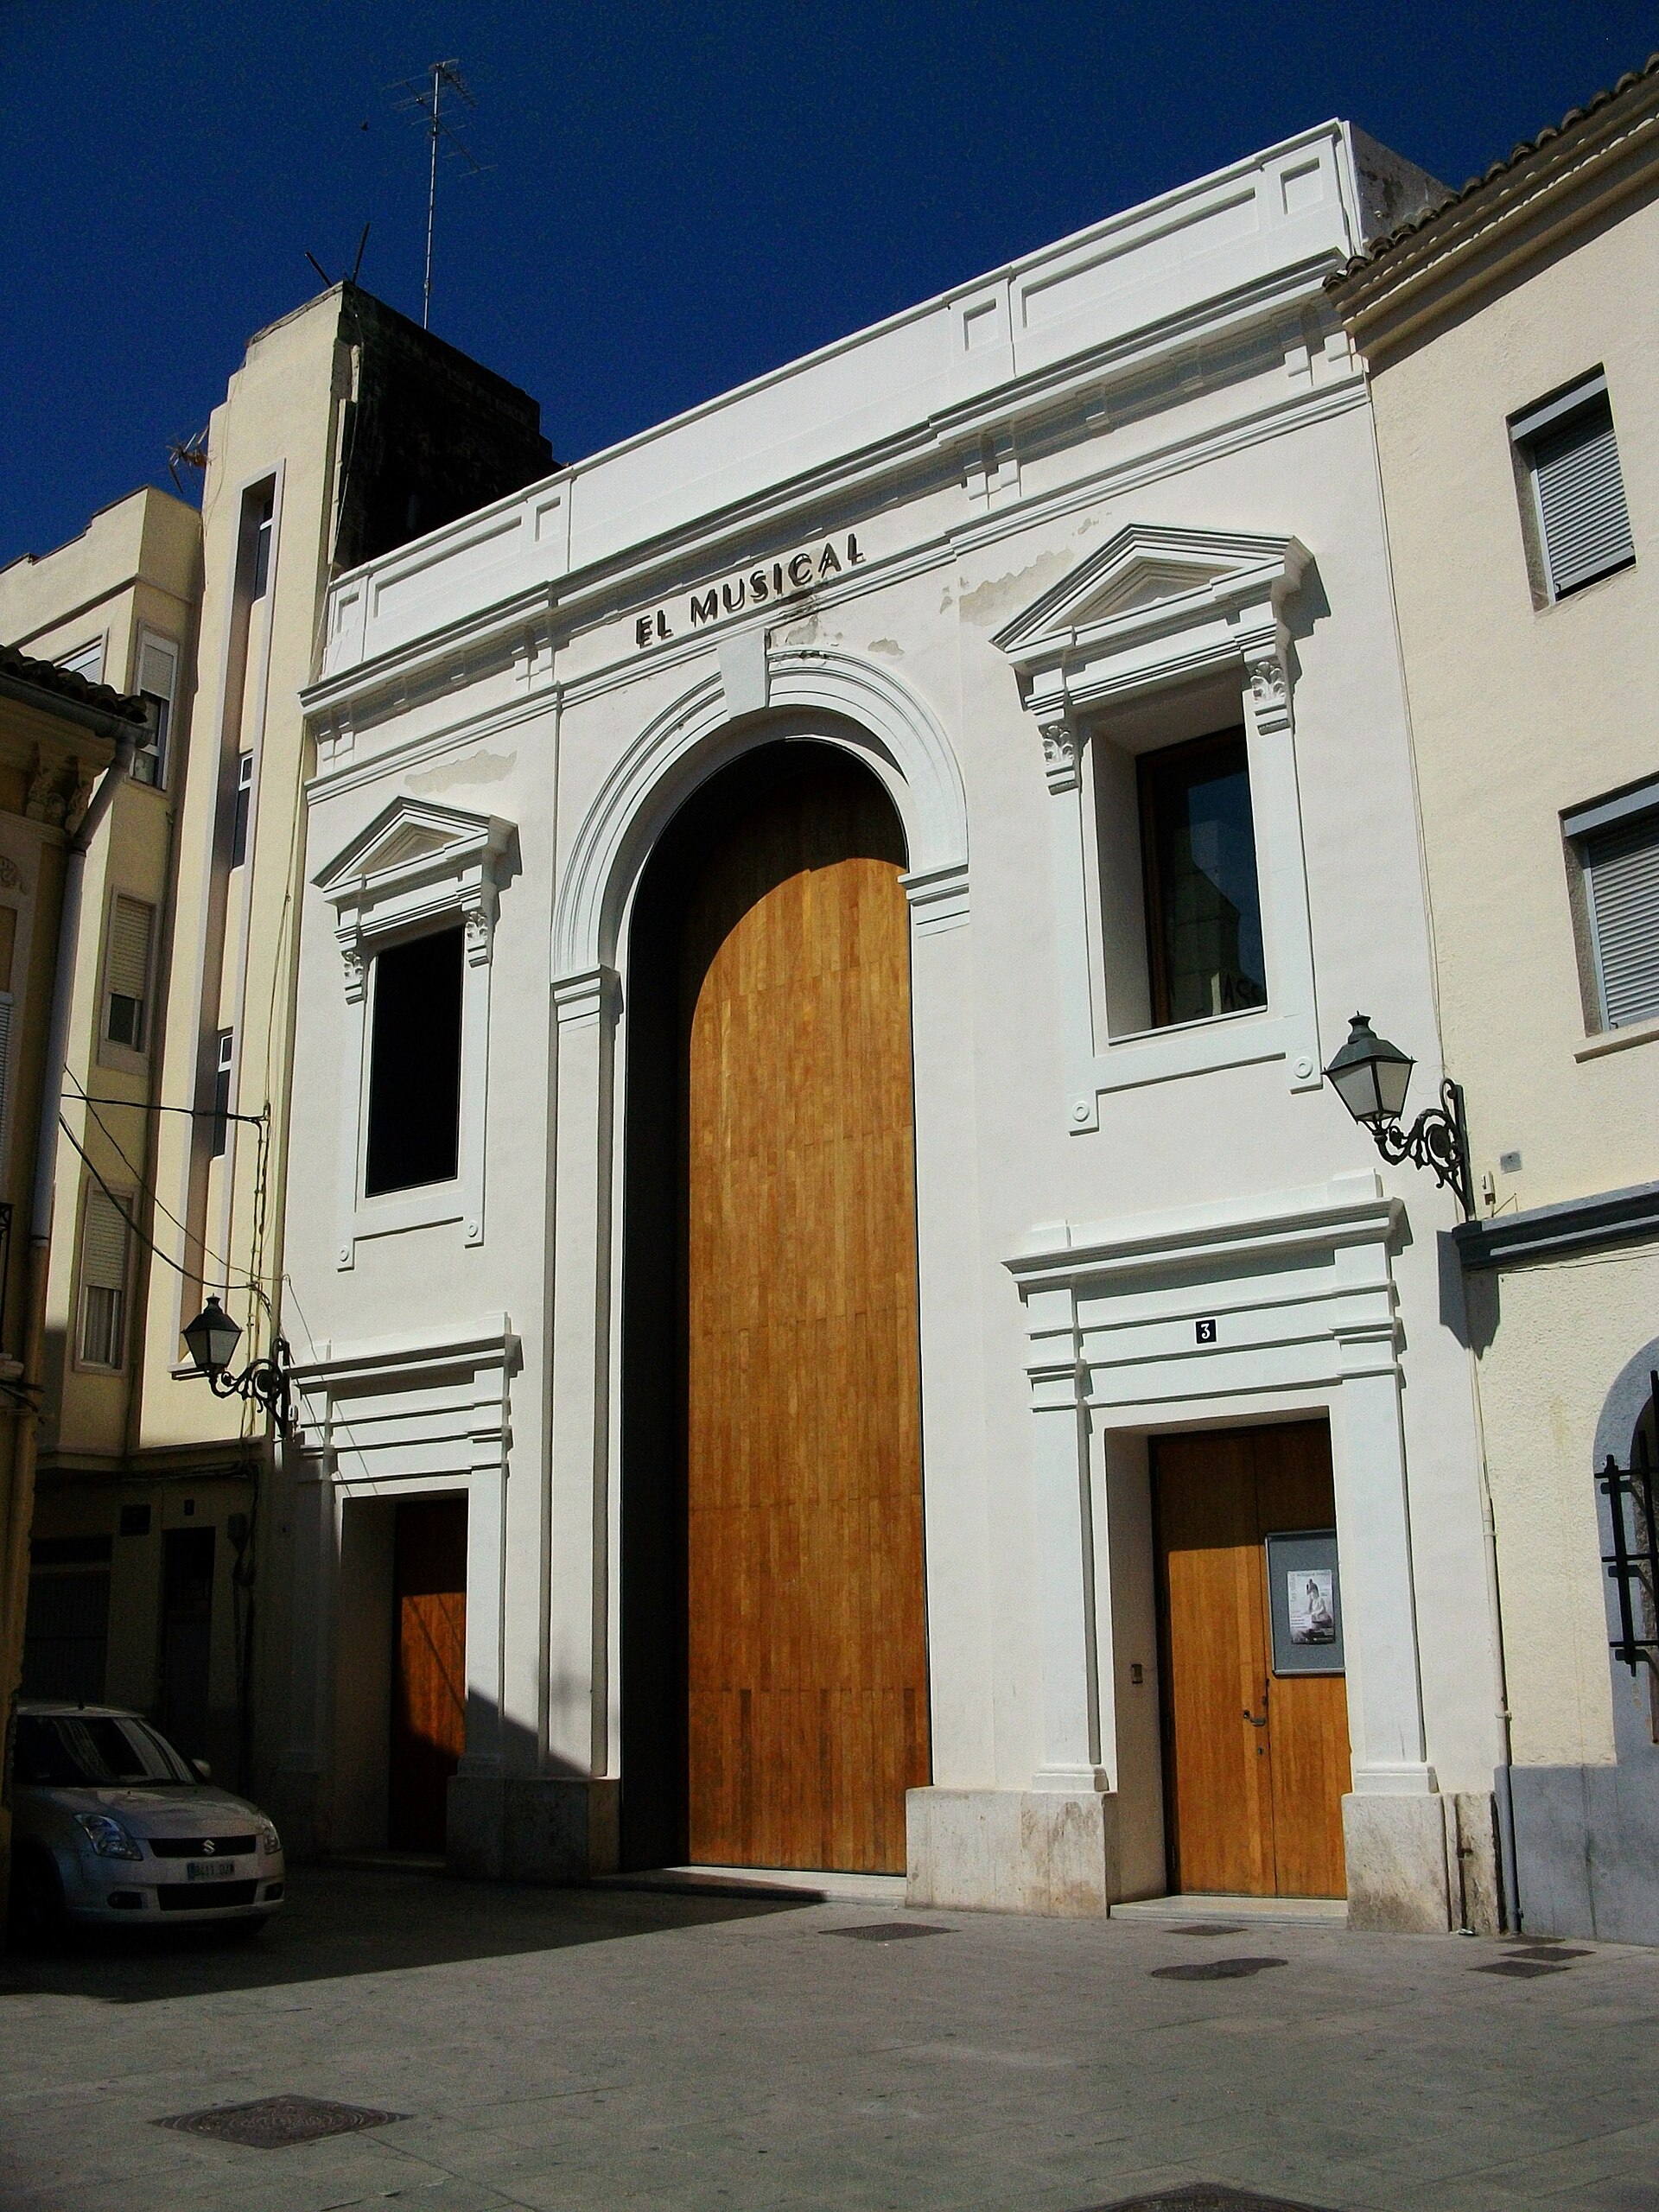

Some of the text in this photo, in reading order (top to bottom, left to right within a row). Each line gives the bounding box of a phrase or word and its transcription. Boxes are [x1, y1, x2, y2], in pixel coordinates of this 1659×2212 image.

[636, 533, 867, 649] EL MUSICAL
[1200, 1323, 1211, 1339] 3
